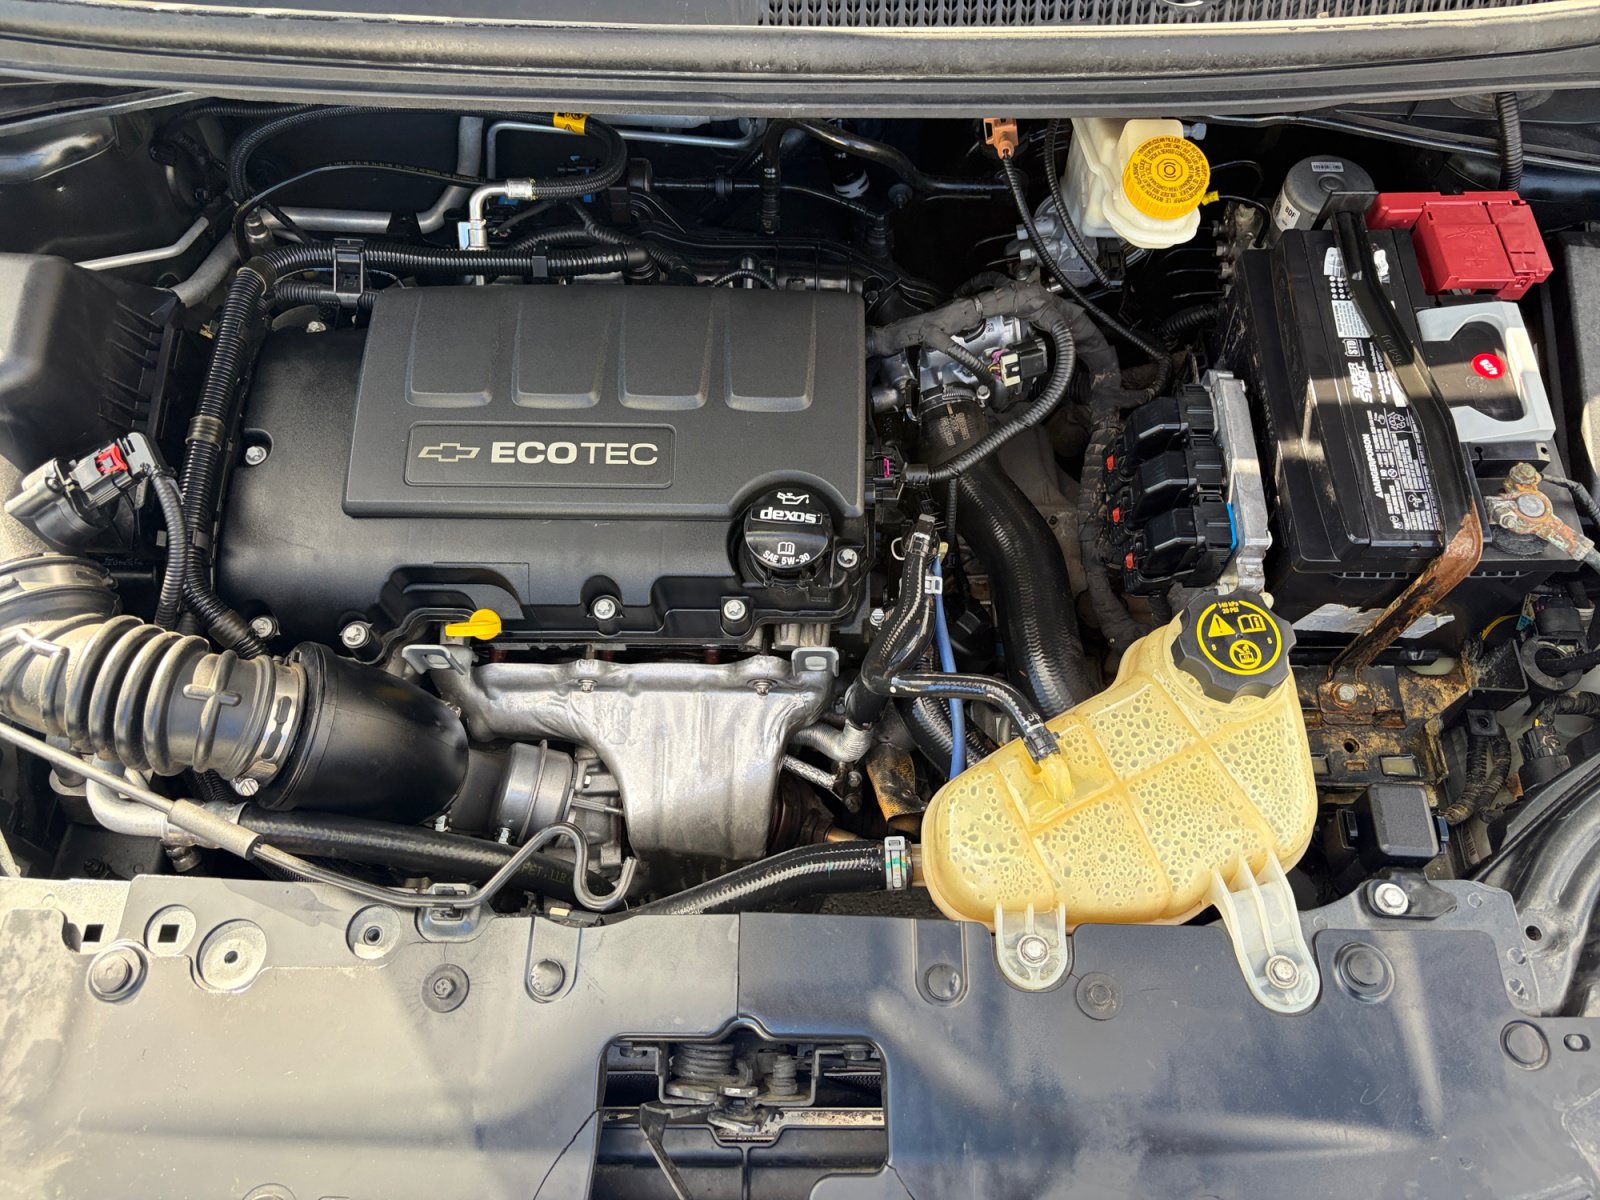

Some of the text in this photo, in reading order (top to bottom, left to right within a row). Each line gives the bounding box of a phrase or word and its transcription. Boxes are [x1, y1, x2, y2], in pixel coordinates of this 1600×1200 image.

[490, 441, 658, 466] ECOTEC
[760, 507, 817, 524] dexos
[762, 550, 810, 565] SAE 5W-30
